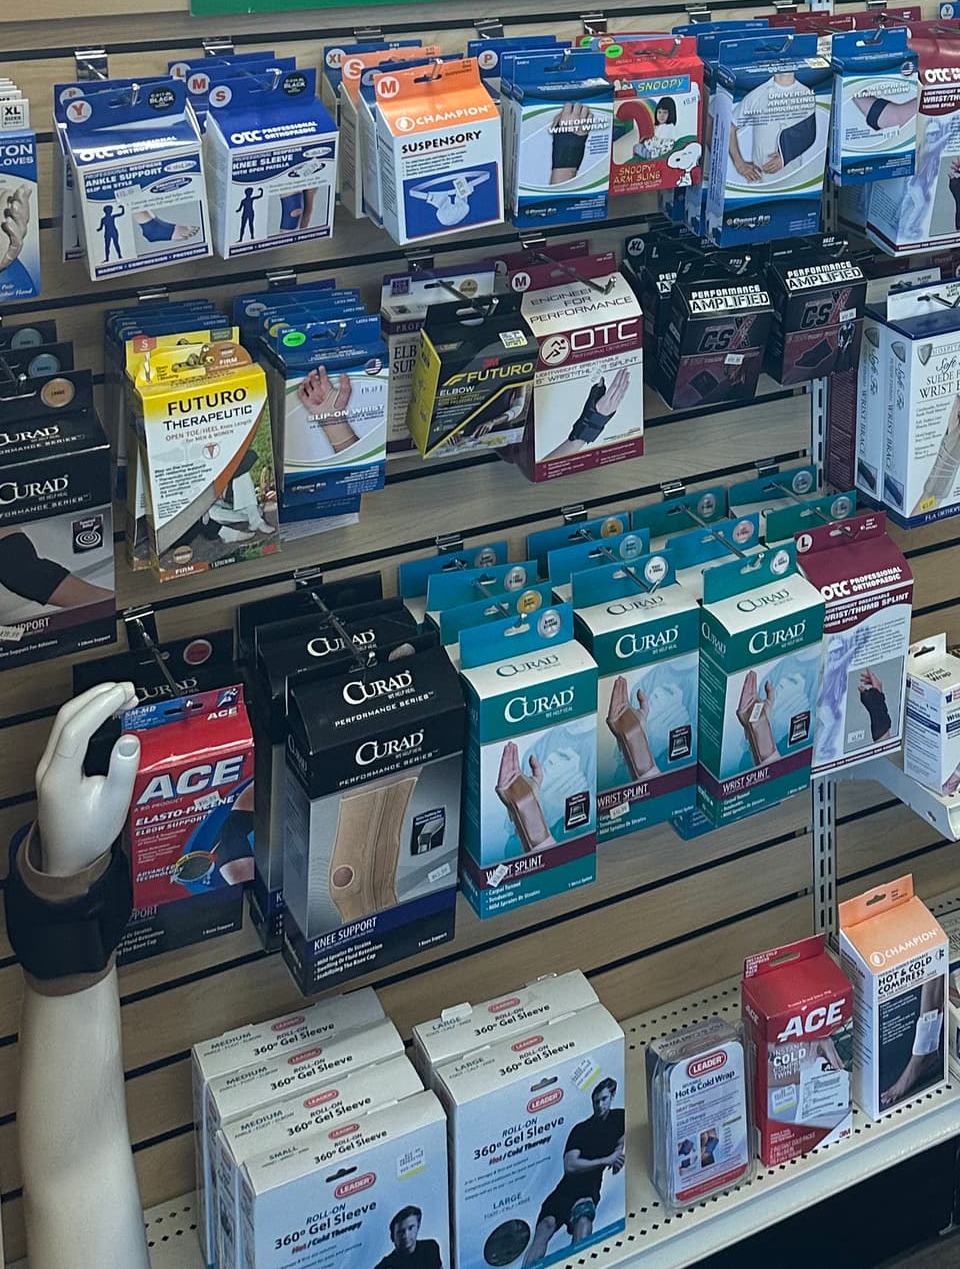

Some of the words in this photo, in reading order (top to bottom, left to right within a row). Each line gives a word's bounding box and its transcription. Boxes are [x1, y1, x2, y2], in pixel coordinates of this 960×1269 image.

[637, 79, 684, 91] SNOOPY
[768, 89, 816, 99] UNIVERSAL
[5, 107, 21, 115] XL
[416, 106, 490, 126] CHAMPION
[262, 122, 317, 134] PROFESSIONAL
[265, 127, 316, 139] ORTHOPAEDIC
[582, 123, 610, 131] WRAP
[402, 131, 482, 154] SUSPENSORY
[233, 159, 258, 169] KNEE
[260, 154, 294, 165] SLEEVE
[85, 174, 117, 187] ANKLE
[120, 168, 162, 180] SUPPORT
[614, 175, 633, 185] ARM
[637, 171, 660, 181] SLING
[629, 240, 642, 252] XL
[787, 261, 852, 278] PERFORMANCE
[788, 269, 862, 290] AMPLIFIED
[564, 296, 592, 307] FOR
[691, 285, 761, 300] PERFORMANCE
[692, 292, 770, 313] AMPLIFIED
[530, 296, 633, 324] PERFORMANCE
[570, 320, 638, 351] OTC
[467, 363, 533, 382] FUTURO
[926, 371, 955, 386] SUEDE
[440, 386, 475, 396] ELBOW
[919, 382, 954, 399] WRIST
[168, 388, 247, 416] FUTURO
[163, 405, 252, 431] THERAPEUTIC
[175, 564, 194, 575] FIRM
[850, 567, 902, 585] PROFESSIONAL
[852, 573, 901, 591] ORTHOPAEDIC
[607, 595, 664, 615] CURAD
[737, 589, 790, 612] CURAD
[882, 592, 909, 606] SPLINT
[615, 627, 679, 659] CURAD
[748, 622, 805, 654] CURAD
[496, 655, 558, 677] CURAD
[343, 672, 412, 705] CURAD
[207, 708, 237, 720] ACE
[335, 704, 397, 727] PERFORMANCE
[400, 694, 429, 707] SERIES
[505, 689, 574, 723] CURAD
[355, 731, 424, 766] CURAD
[136, 755, 244, 806] ACE
[723, 776, 745, 793] WRIST
[745, 767, 769, 782] SPLINT
[598, 792, 622, 809] WRIST
[623, 783, 649, 799] SPLINT
[135, 824, 166, 836] ELBOW
[168, 815, 206, 829] SUPPORT
[515, 855, 542, 872] SPLINT
[314, 935, 337, 950] KNEE
[338, 917, 377, 941] SUPPORT
[884, 929, 937, 959] CHAMPION
[878, 975, 894, 987] HOT
[897, 971, 906, 981] &
[909, 956, 932, 973] COLD
[878, 968, 925, 995] COMPRESS
[778, 999, 845, 1042] ACE
[211, 1032, 252, 1049] MEDIUM
[691, 1055, 723, 1075] LEADER
[773, 1048, 806, 1067] COLD
[675, 1086, 689, 1099] Hot
[690, 1083, 697, 1094] &
[699, 1075, 713, 1090] Cold
[715, 1069, 735, 1083] Wrap
[310, 1101, 343, 1117] ROLL-ON
[531, 1093, 558, 1108] LEADER
[241, 1110, 283, 1131] MEDIUM
[502, 1117, 538, 1138] ROLL-ON
[340, 1176, 370, 1194] LEADER
[492, 1193, 522, 1209] LARGE
[306, 1203, 346, 1225] ROLL-ON
